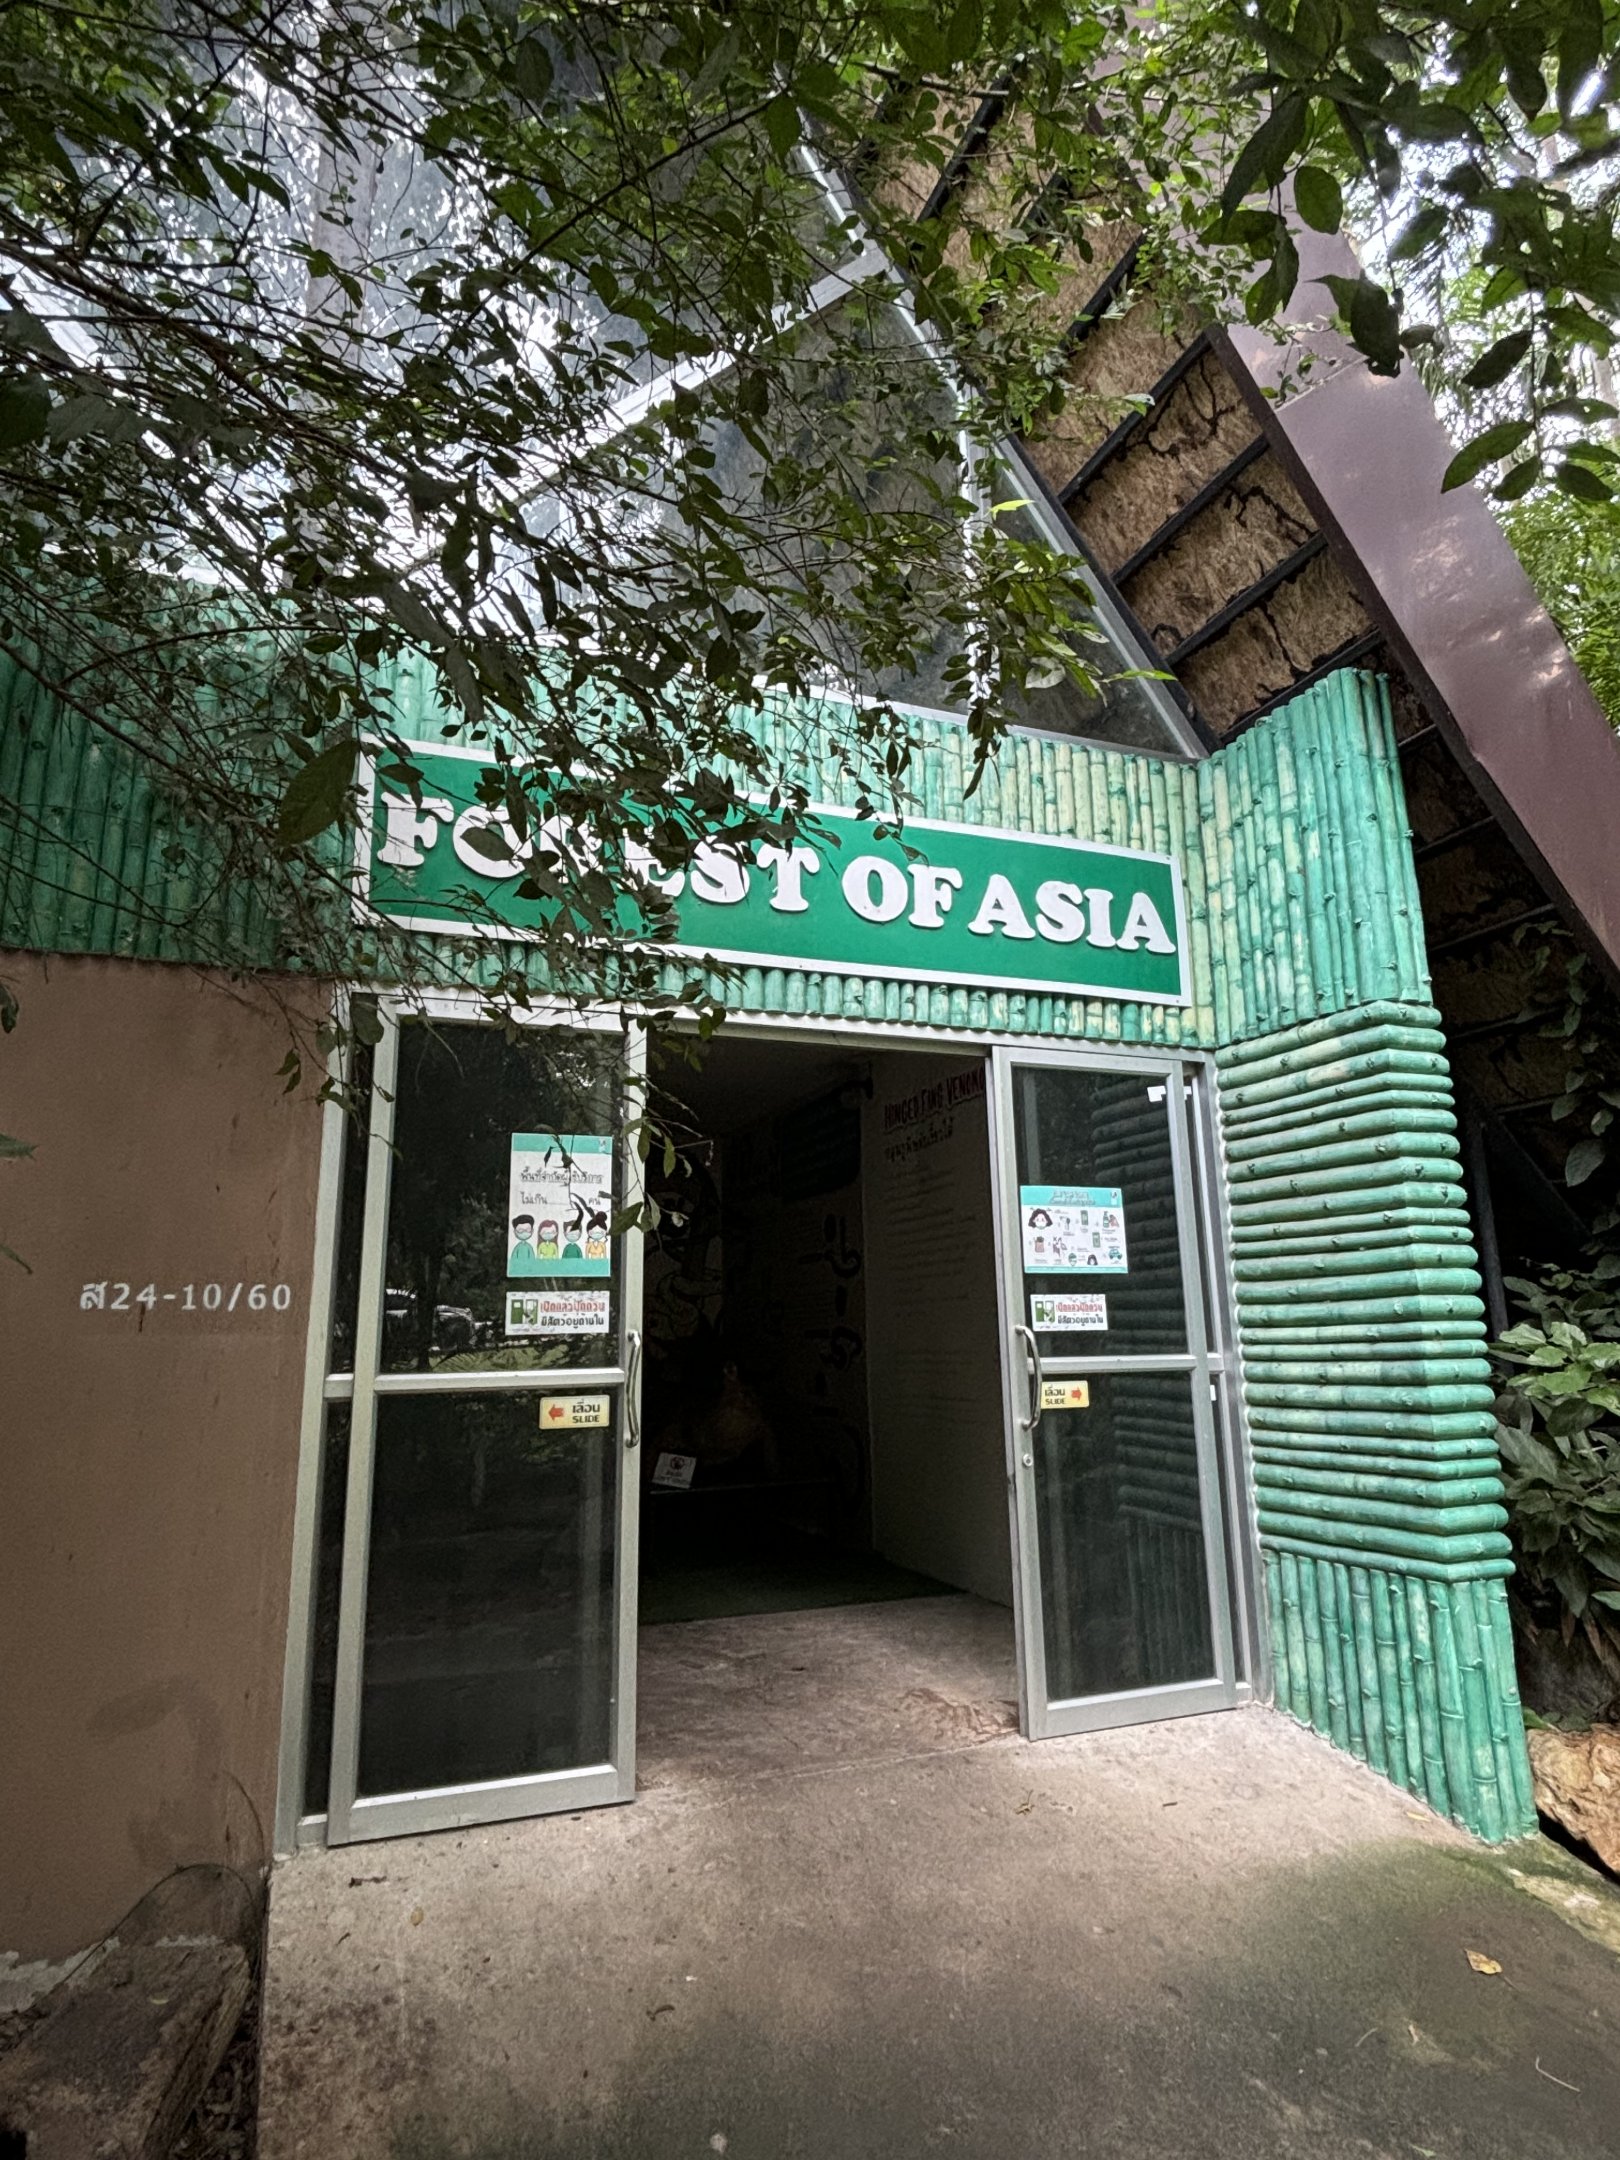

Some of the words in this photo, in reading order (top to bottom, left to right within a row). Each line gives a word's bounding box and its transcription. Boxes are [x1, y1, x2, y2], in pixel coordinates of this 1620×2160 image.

[842, 855, 963, 929] OF
[967, 873, 1177, 954] ASIA
[1044, 1386, 1066, 1397] เลื่อน
[572, 1398, 601, 1413] เลื่อน
[572, 1415, 600, 1424] SLIDE
